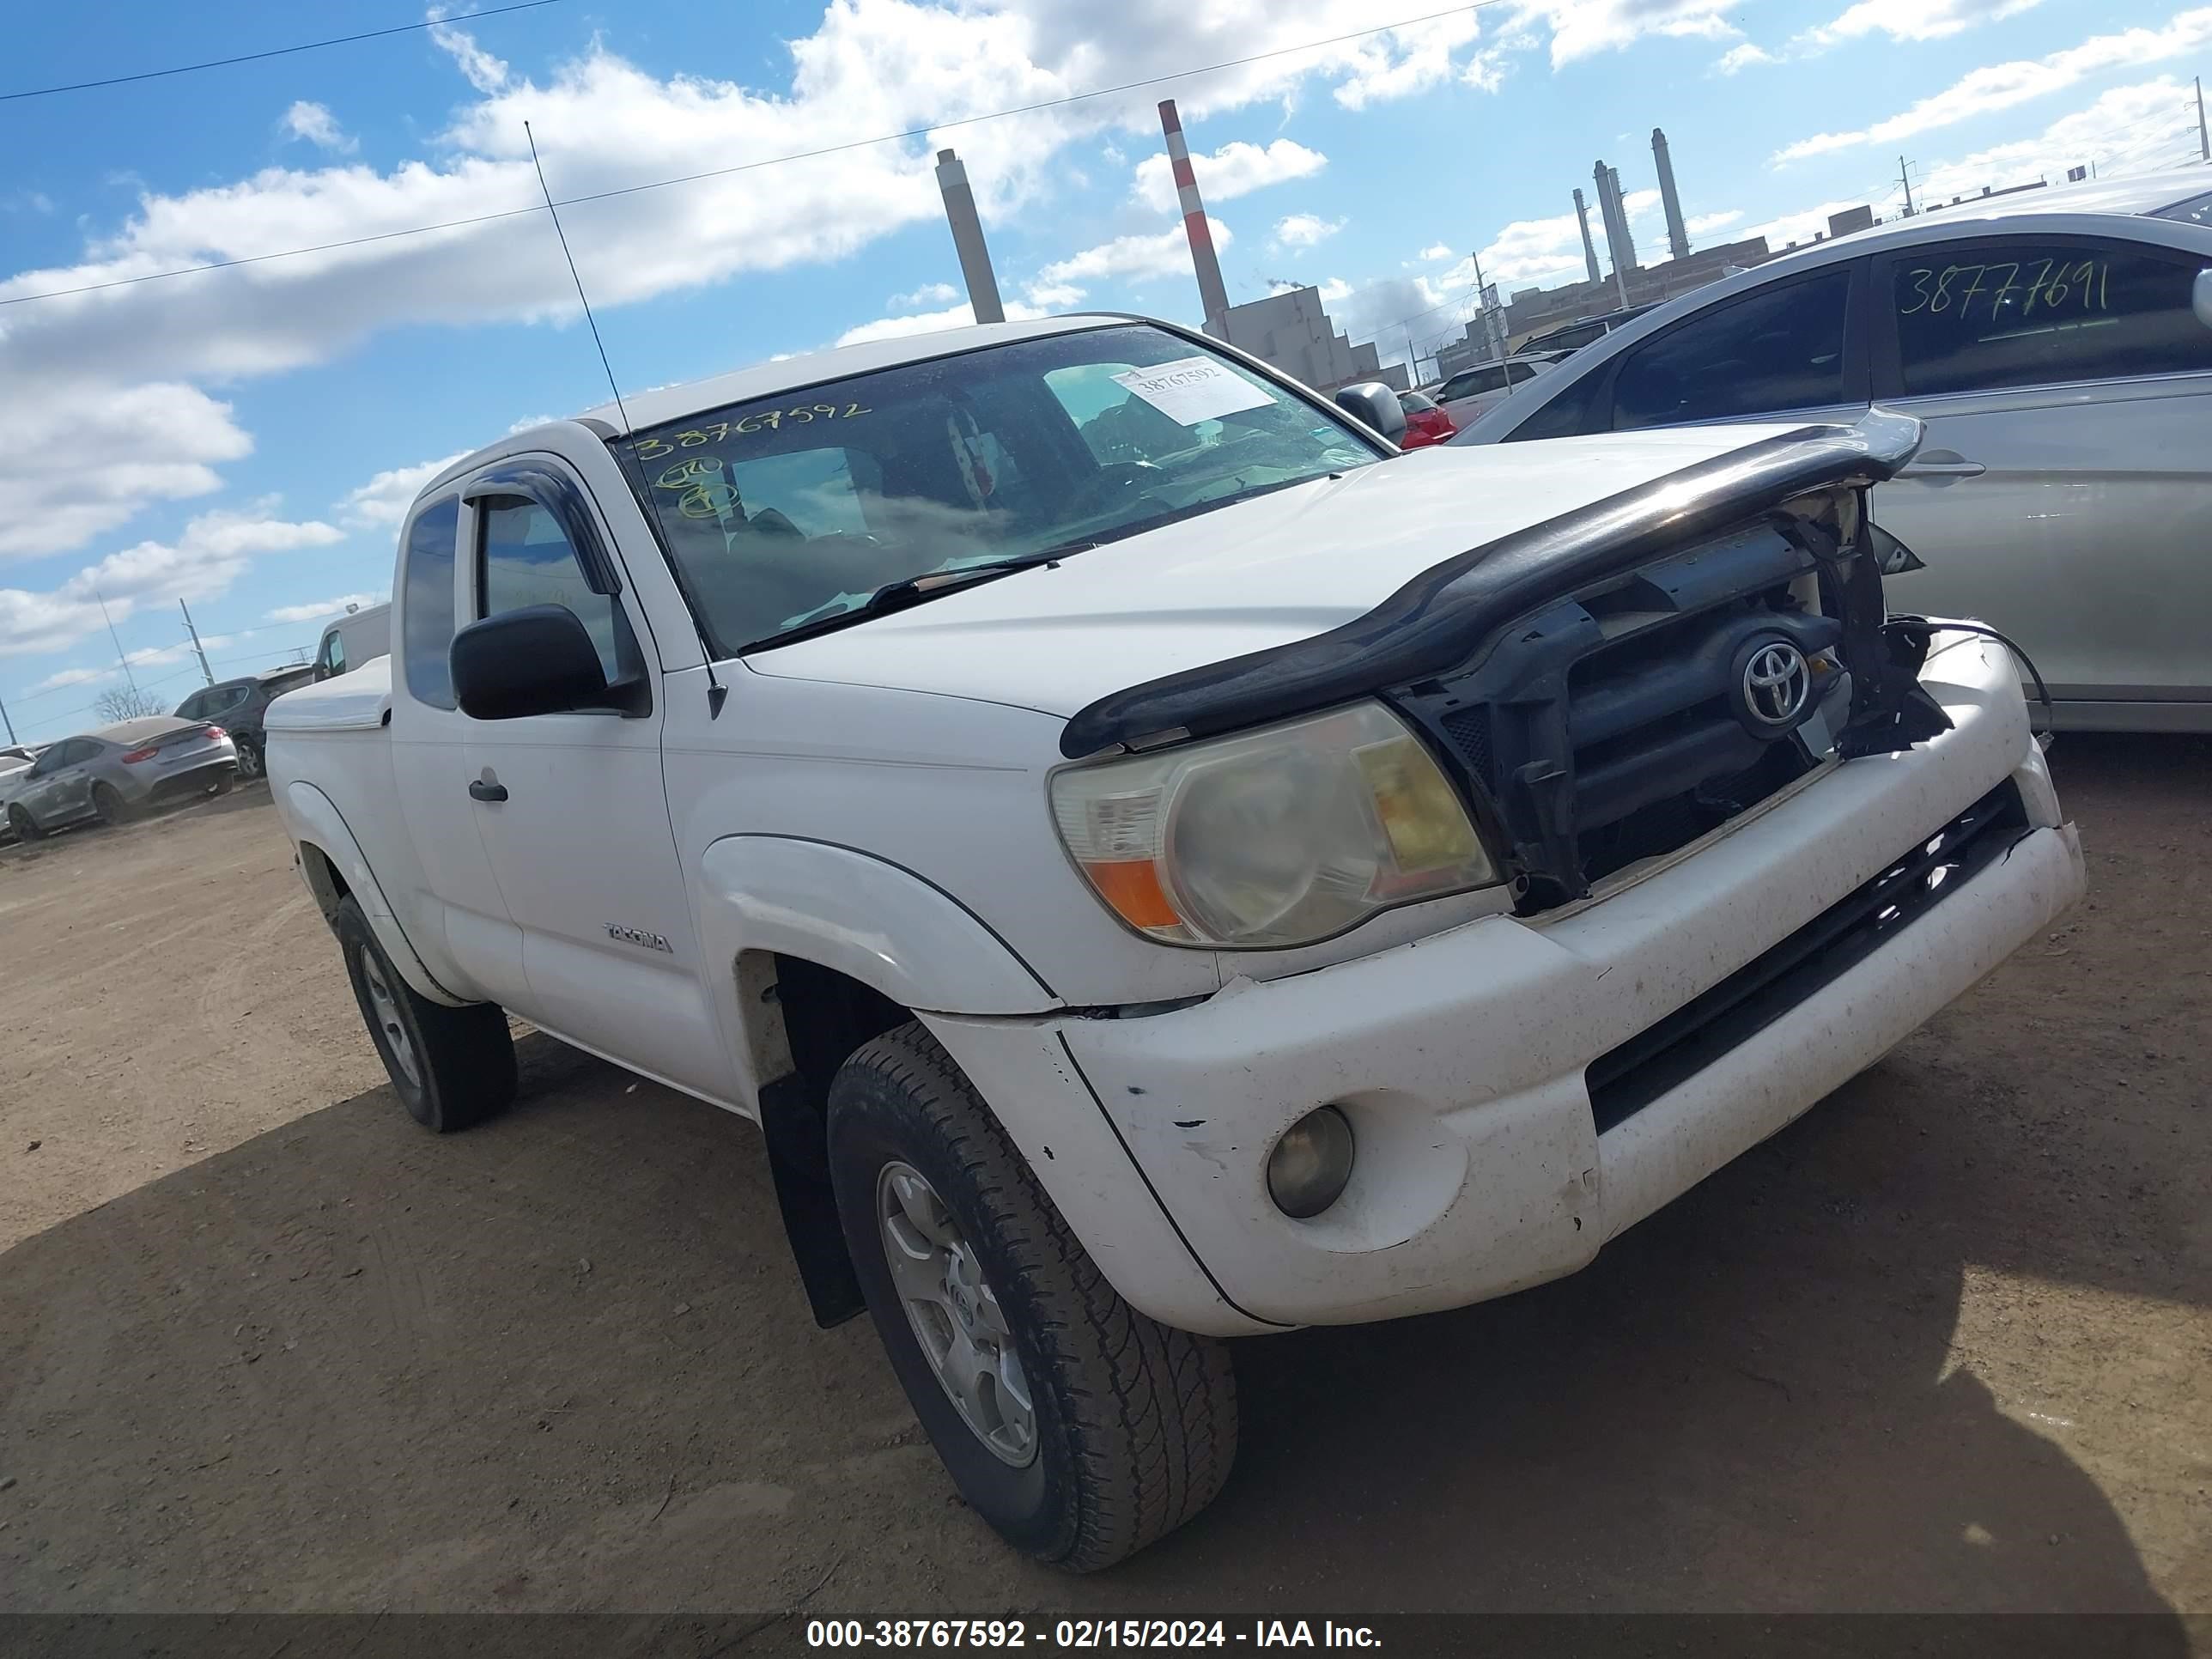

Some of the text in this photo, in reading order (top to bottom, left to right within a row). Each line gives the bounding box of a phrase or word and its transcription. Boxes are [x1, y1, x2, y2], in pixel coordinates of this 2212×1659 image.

[1901, 258, 2107, 321] 38777691
[1139, 368, 1221, 393] 38767592
[625, 403, 873, 460] 38767592
[602, 921, 674, 954] TACOMA
